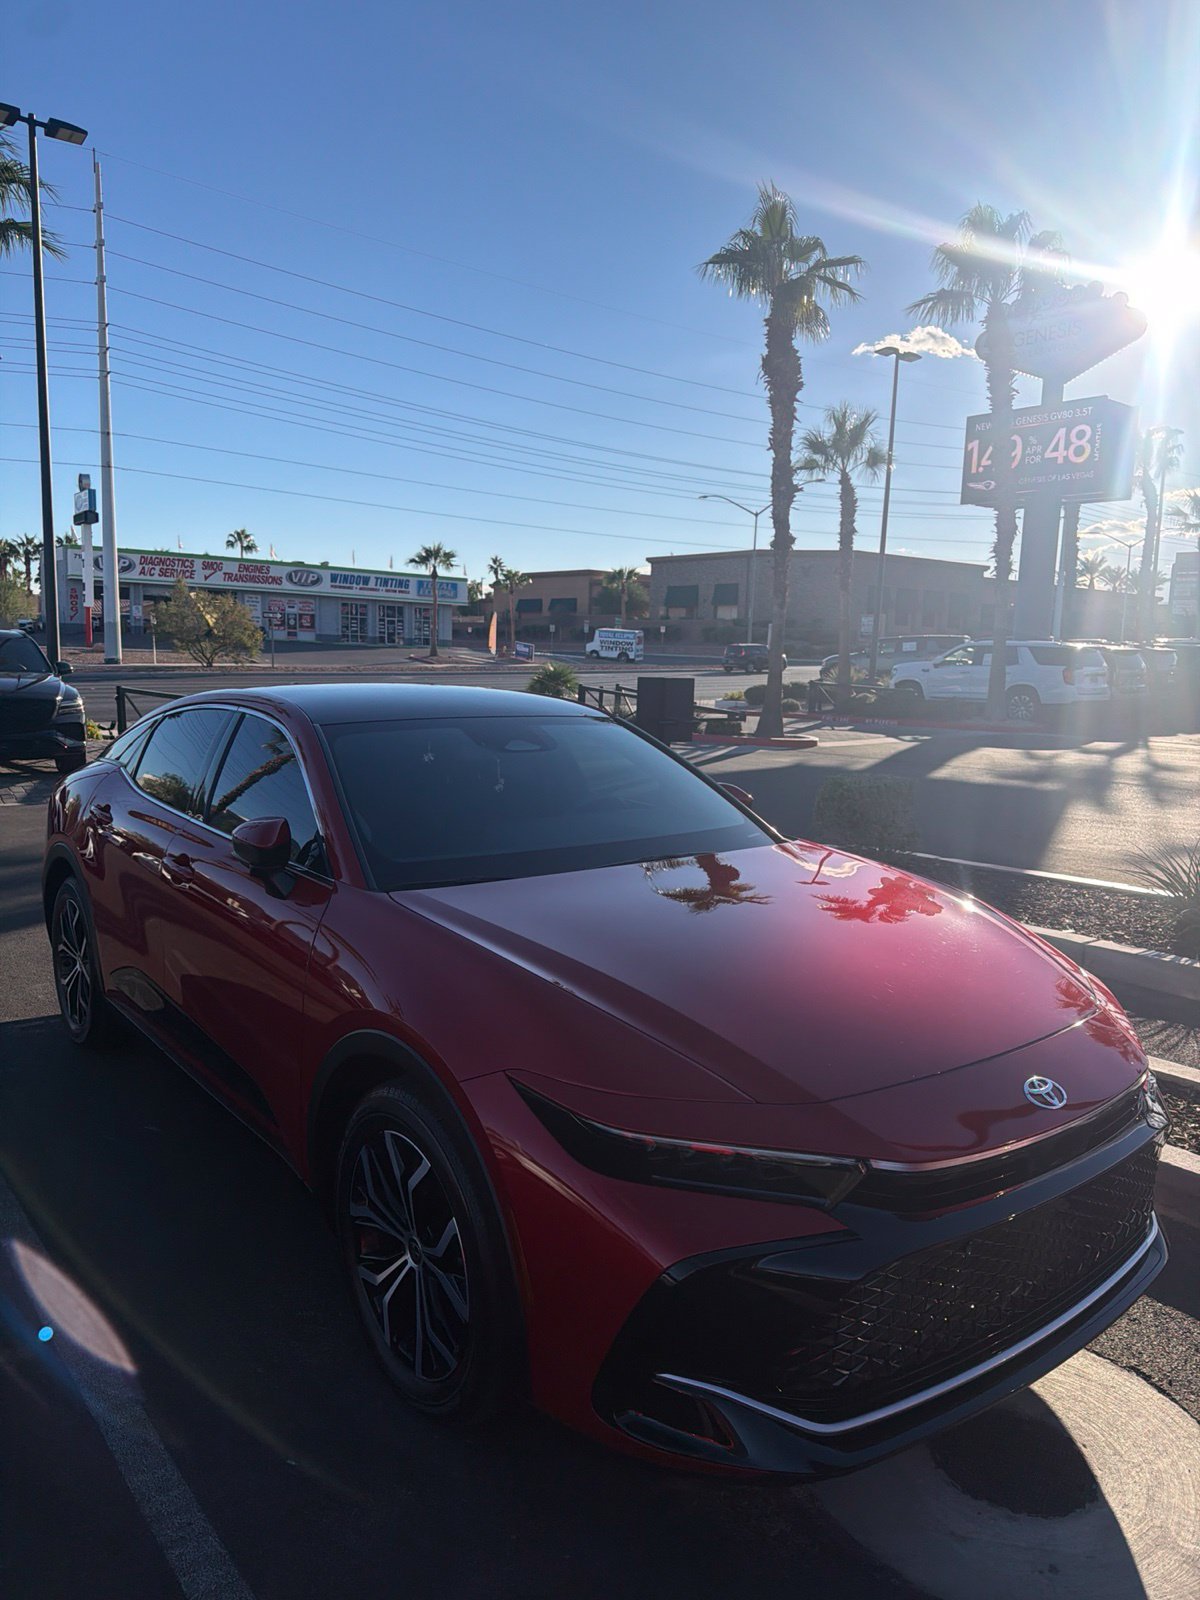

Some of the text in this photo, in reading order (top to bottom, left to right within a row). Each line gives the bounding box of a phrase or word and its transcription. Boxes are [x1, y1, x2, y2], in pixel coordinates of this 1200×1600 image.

[1014, 320, 1082, 348] GENESIS
[1015, 413, 1049, 425] GENESIS
[1050, 411, 1073, 421] GV80
[1075, 407, 1093, 417] 3.5T
[1025, 445, 1042, 454] APR
[1044, 424, 1092, 464] 48
[1025, 455, 1042, 464] FOR
[1057, 473, 1071, 481] LAS
[139, 555, 195, 570] DIAGNOSTICS
[201, 560, 224, 572] SMOG
[237, 563, 271, 575] ENGINES
[139, 567, 196, 580] A/C SERVICE
[223, 572, 283, 586] TRANSMISSIONS
[330, 573, 371, 587] WINDOW
[374, 576, 410, 590] TINTING
[600, 639, 633, 647] WINDOW
